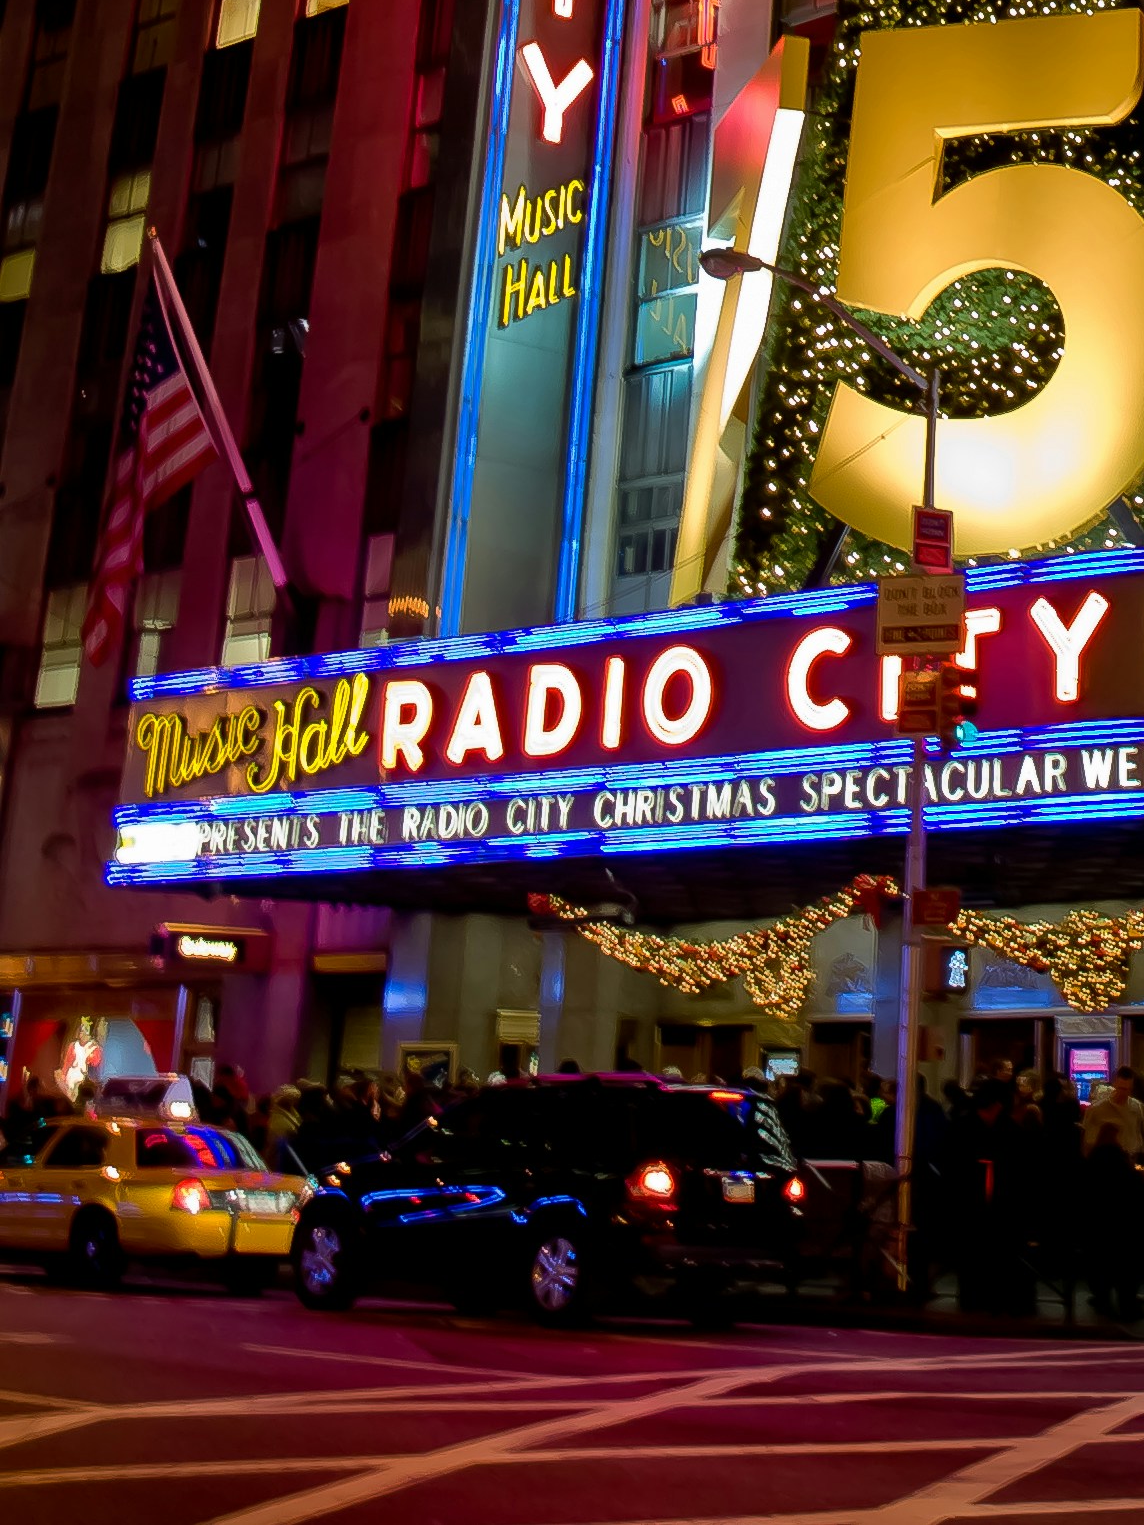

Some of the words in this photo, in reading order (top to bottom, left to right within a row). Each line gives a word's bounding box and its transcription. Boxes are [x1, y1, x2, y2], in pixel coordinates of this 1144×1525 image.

[500, 179, 584, 255] MUSIC
[501, 253, 577, 328] HALL
[137, 704, 262, 797] Music
[245, 672, 370, 793] Hall
[382, 646, 712, 772] RADIO
[198, 813, 320, 855] PRESENTS
[338, 806, 388, 845] THE
[402, 800, 489, 841] RADIO
[506, 794, 574, 835] CITY
[593, 777, 776, 829] CHRISTMAS
